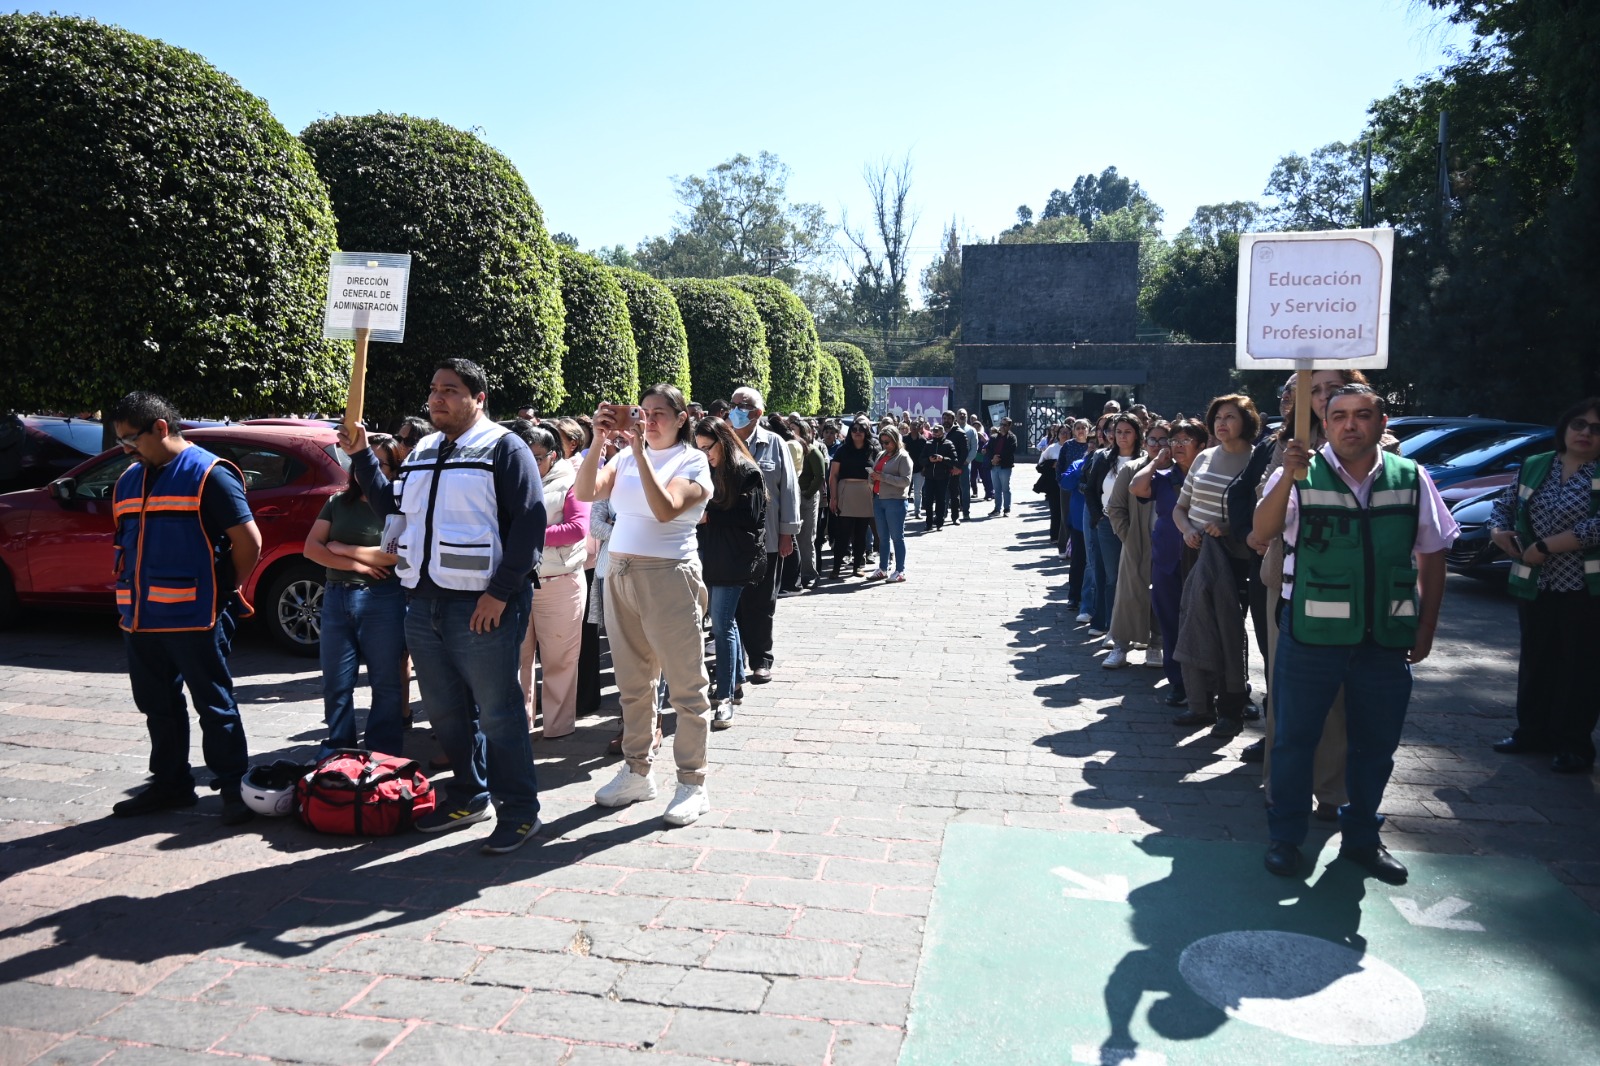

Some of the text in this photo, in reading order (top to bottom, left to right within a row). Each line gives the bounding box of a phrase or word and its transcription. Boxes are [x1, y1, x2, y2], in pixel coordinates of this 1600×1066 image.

[347, 276, 389, 286] DIRECCIÓN
[1269, 270, 1362, 287] Educación
[342, 289, 391, 299] GENERAL DE
[333, 301, 399, 312] ADMINISTRACIÓN
[1270, 298, 1357, 317] y Servicio
[1262, 324, 1363, 340] Profesional
